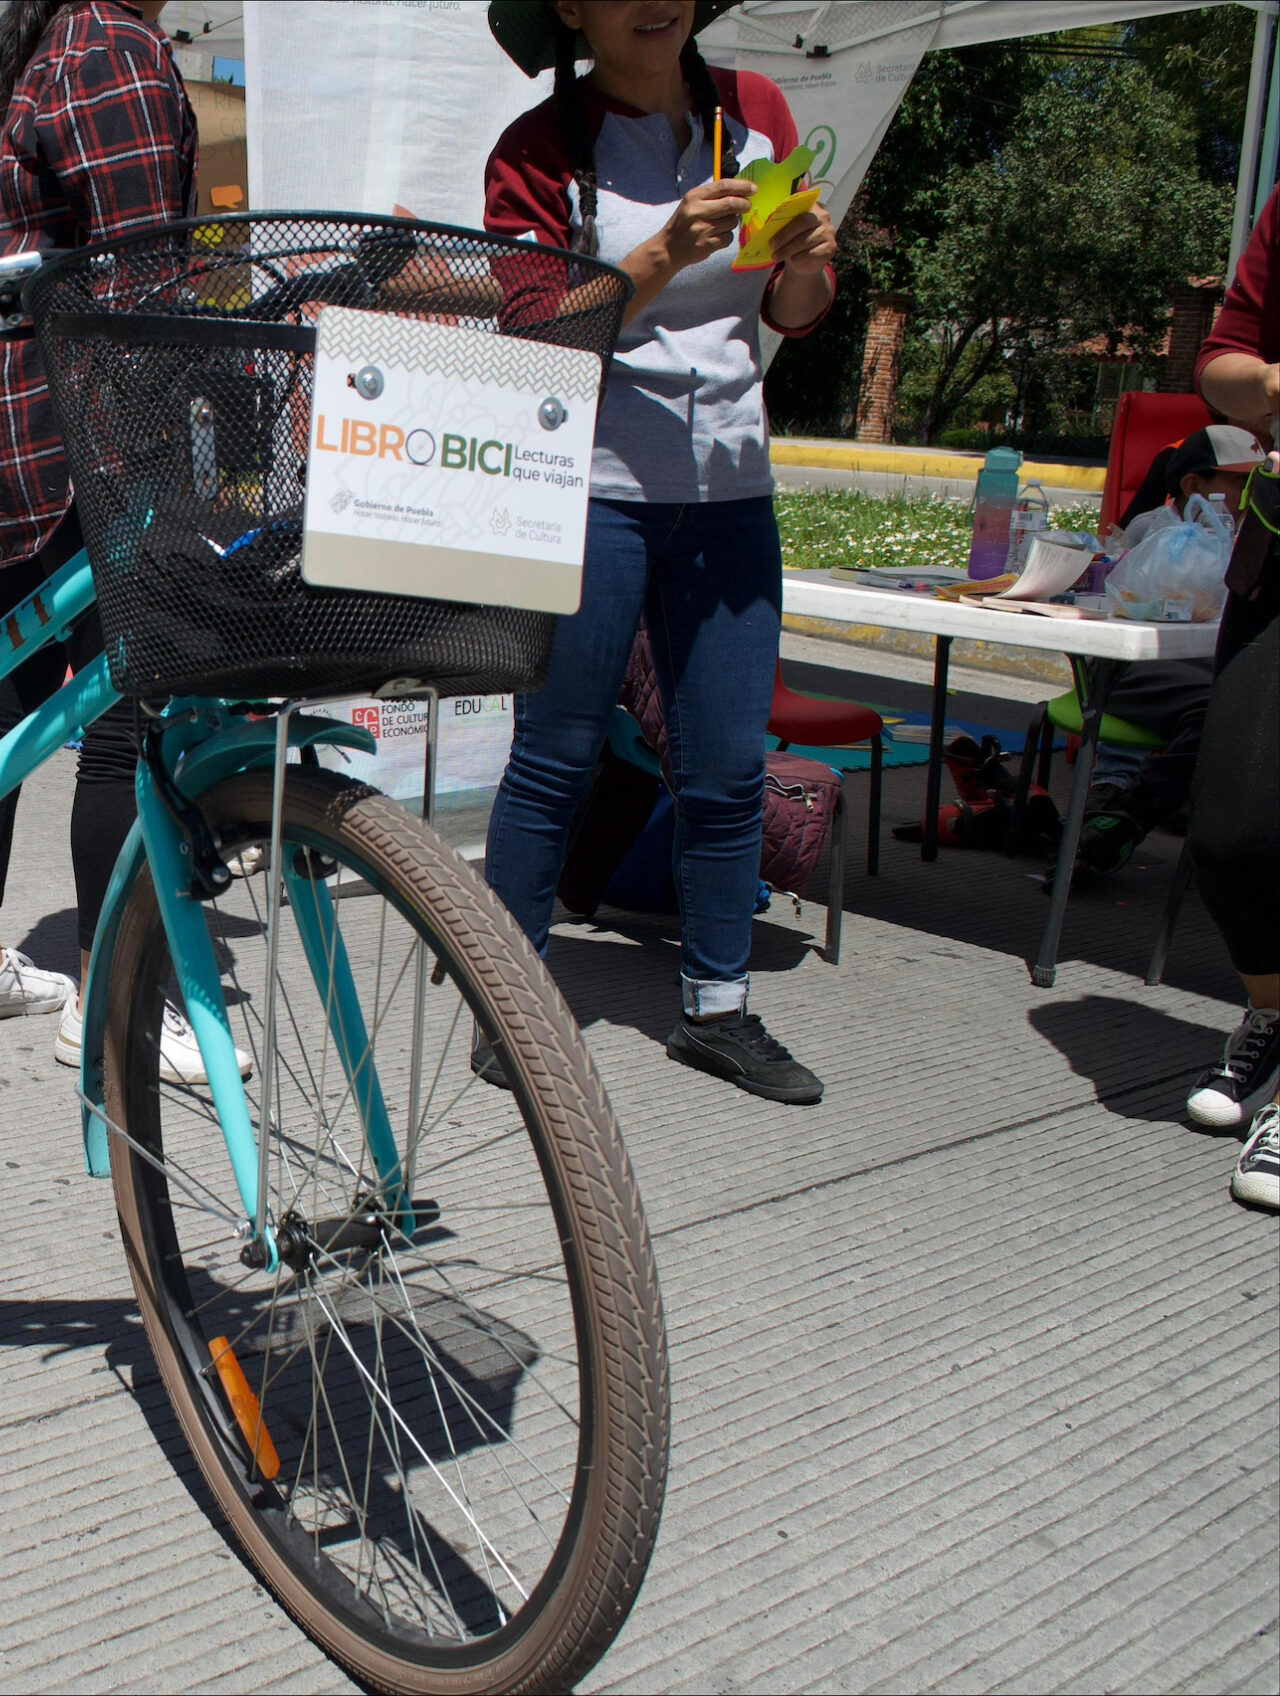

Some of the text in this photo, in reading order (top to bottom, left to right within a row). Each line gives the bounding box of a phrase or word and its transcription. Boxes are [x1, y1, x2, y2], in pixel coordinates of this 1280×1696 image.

[315, 414, 513, 477] LIBRO BICI
[515, 445, 575, 469] Lecturas
[512, 466, 584, 490] que viajan
[354, 499, 434, 517] Gobierno de Puebla
[515, 516, 562, 532] Secretaría
[515, 529, 562, 544] de Cultura
[381, 703, 415, 715] FONDO
[455, 696, 508, 716] EDUCAL
[382, 715, 395, 727] DE
